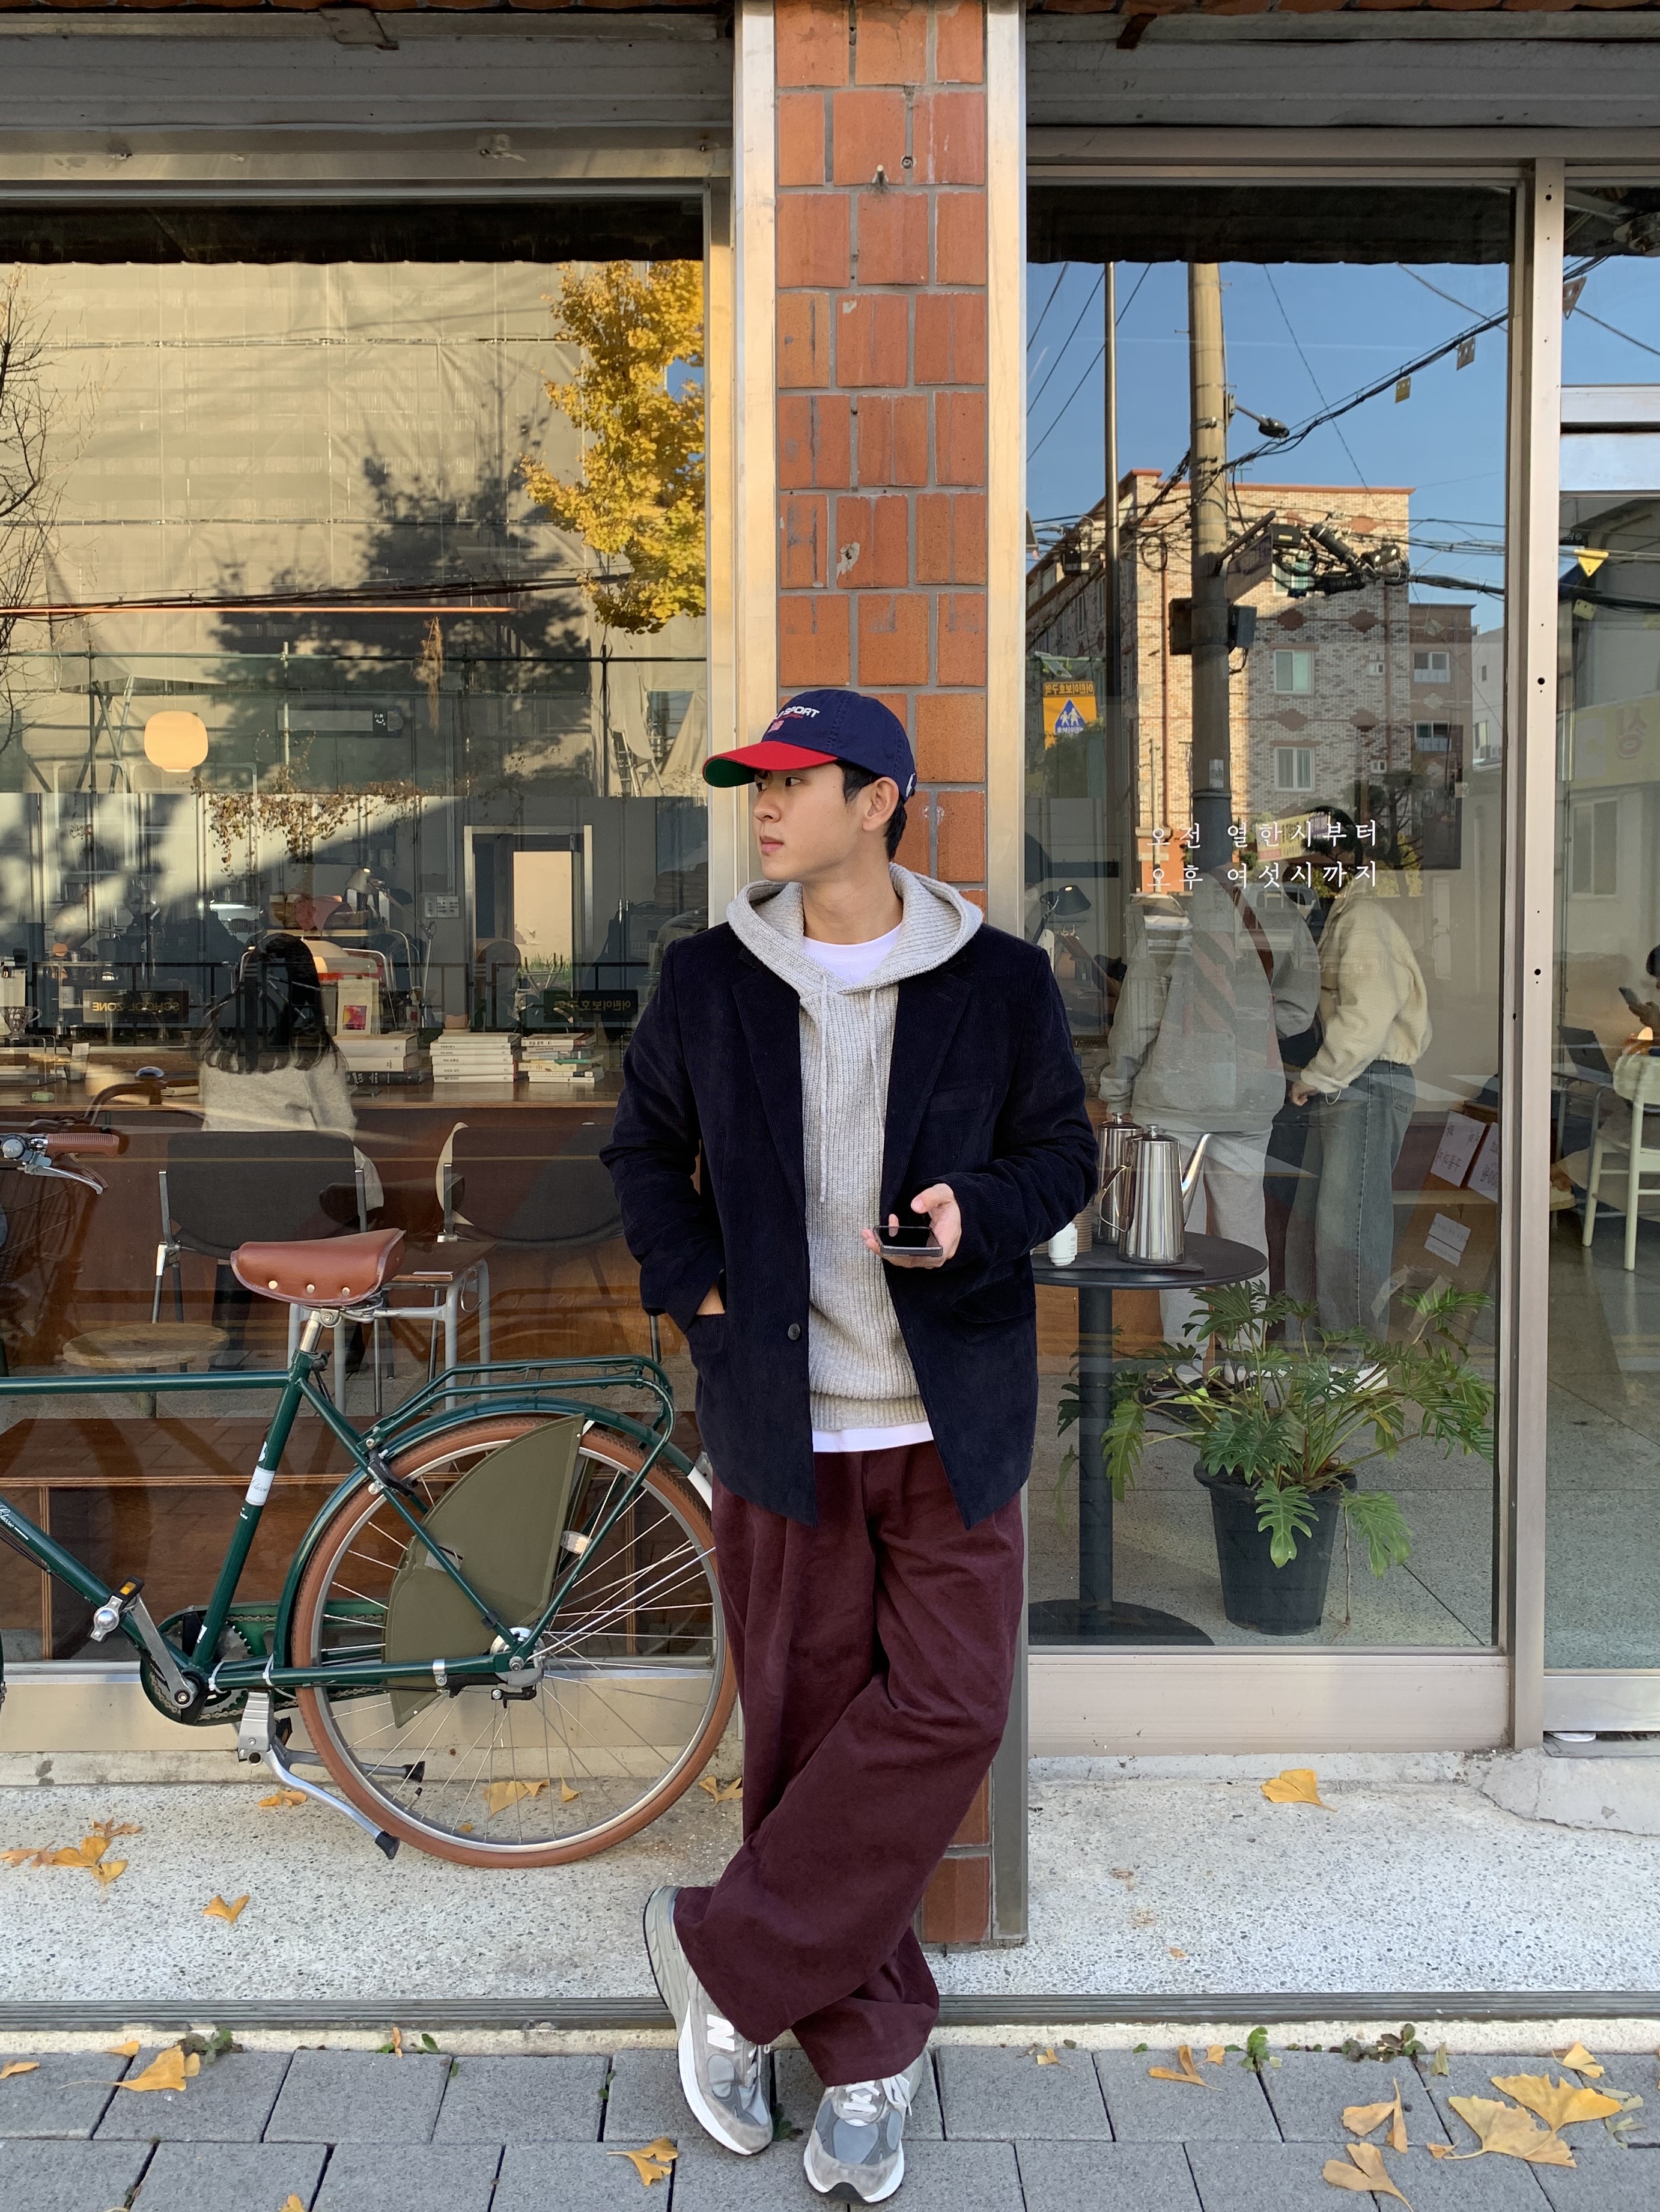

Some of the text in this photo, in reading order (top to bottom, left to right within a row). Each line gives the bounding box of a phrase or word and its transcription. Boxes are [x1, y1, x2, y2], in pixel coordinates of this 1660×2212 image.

[783, 705, 821, 718] SPORT
[1146, 819, 1376, 849] 오전 열한시부터
[1146, 860, 1376, 890] 오후 여섯시까지
[706, 2014, 735, 2052] N
